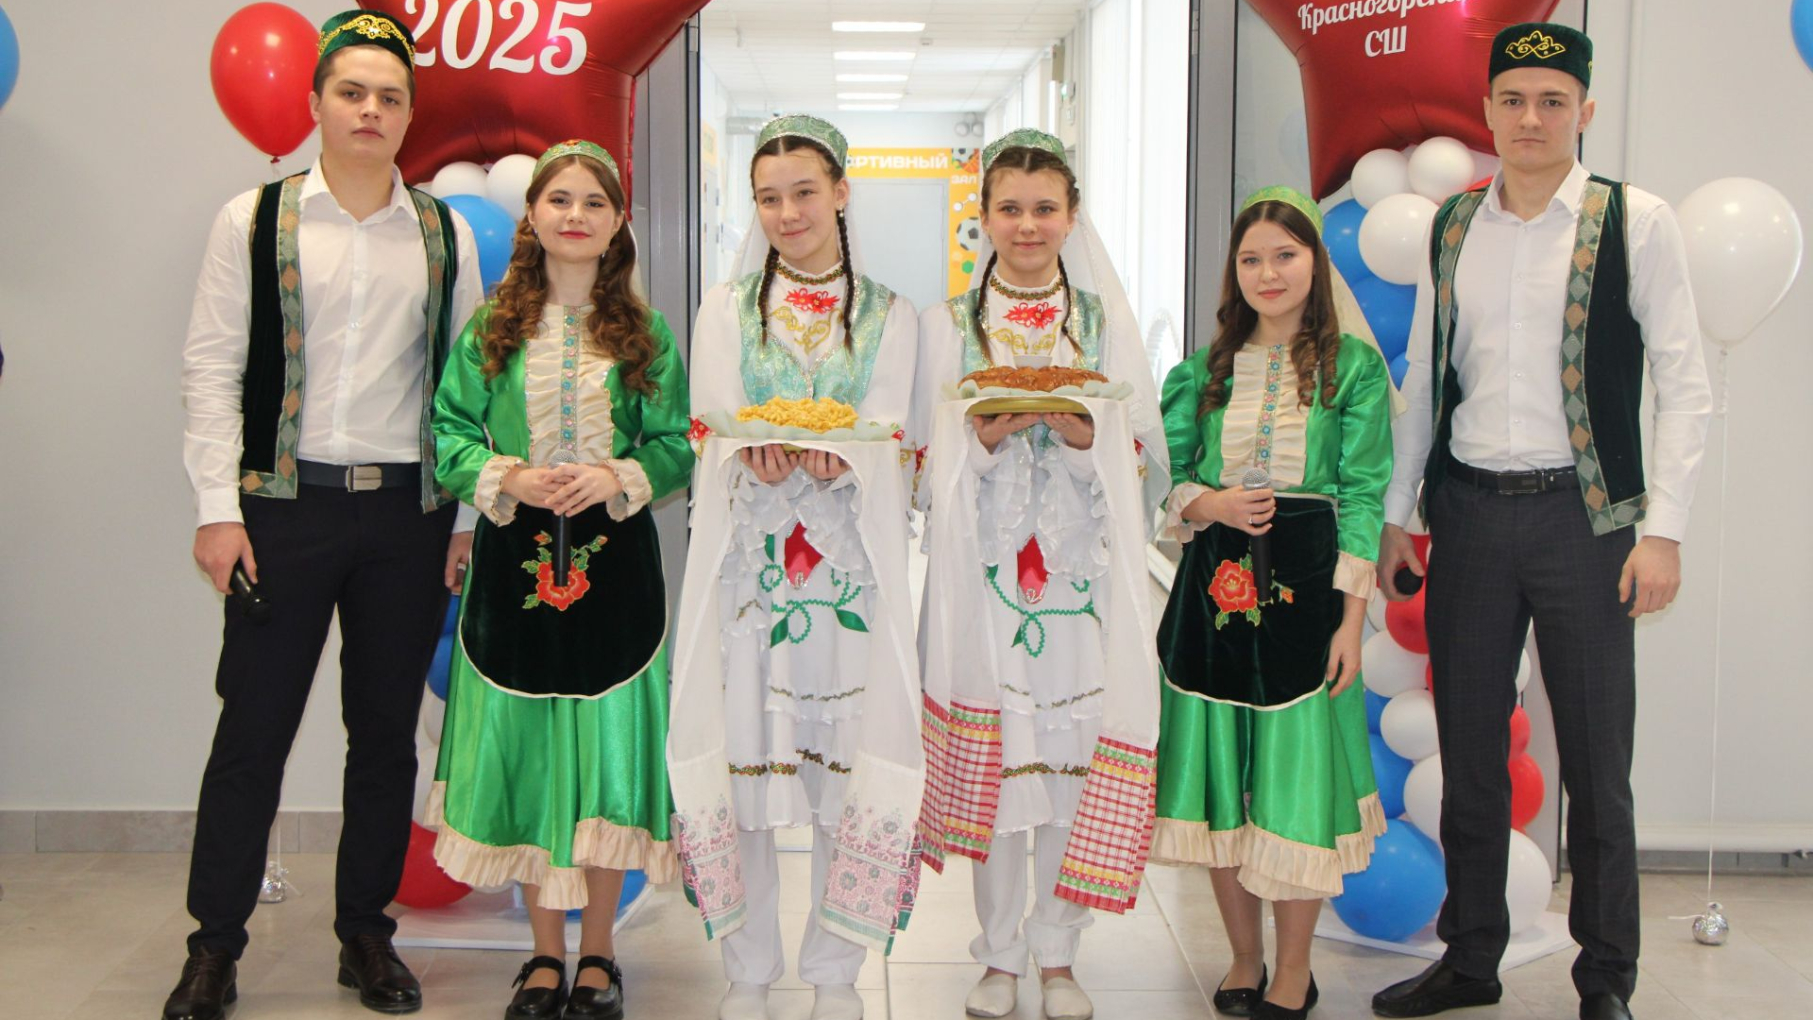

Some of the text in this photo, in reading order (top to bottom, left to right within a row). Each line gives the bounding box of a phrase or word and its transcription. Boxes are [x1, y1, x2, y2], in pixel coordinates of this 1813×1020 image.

[1298, 0, 1461, 35] Красногор
[405, 0, 592, 75] 2025
[1365, 26, 1407, 57] СШ
